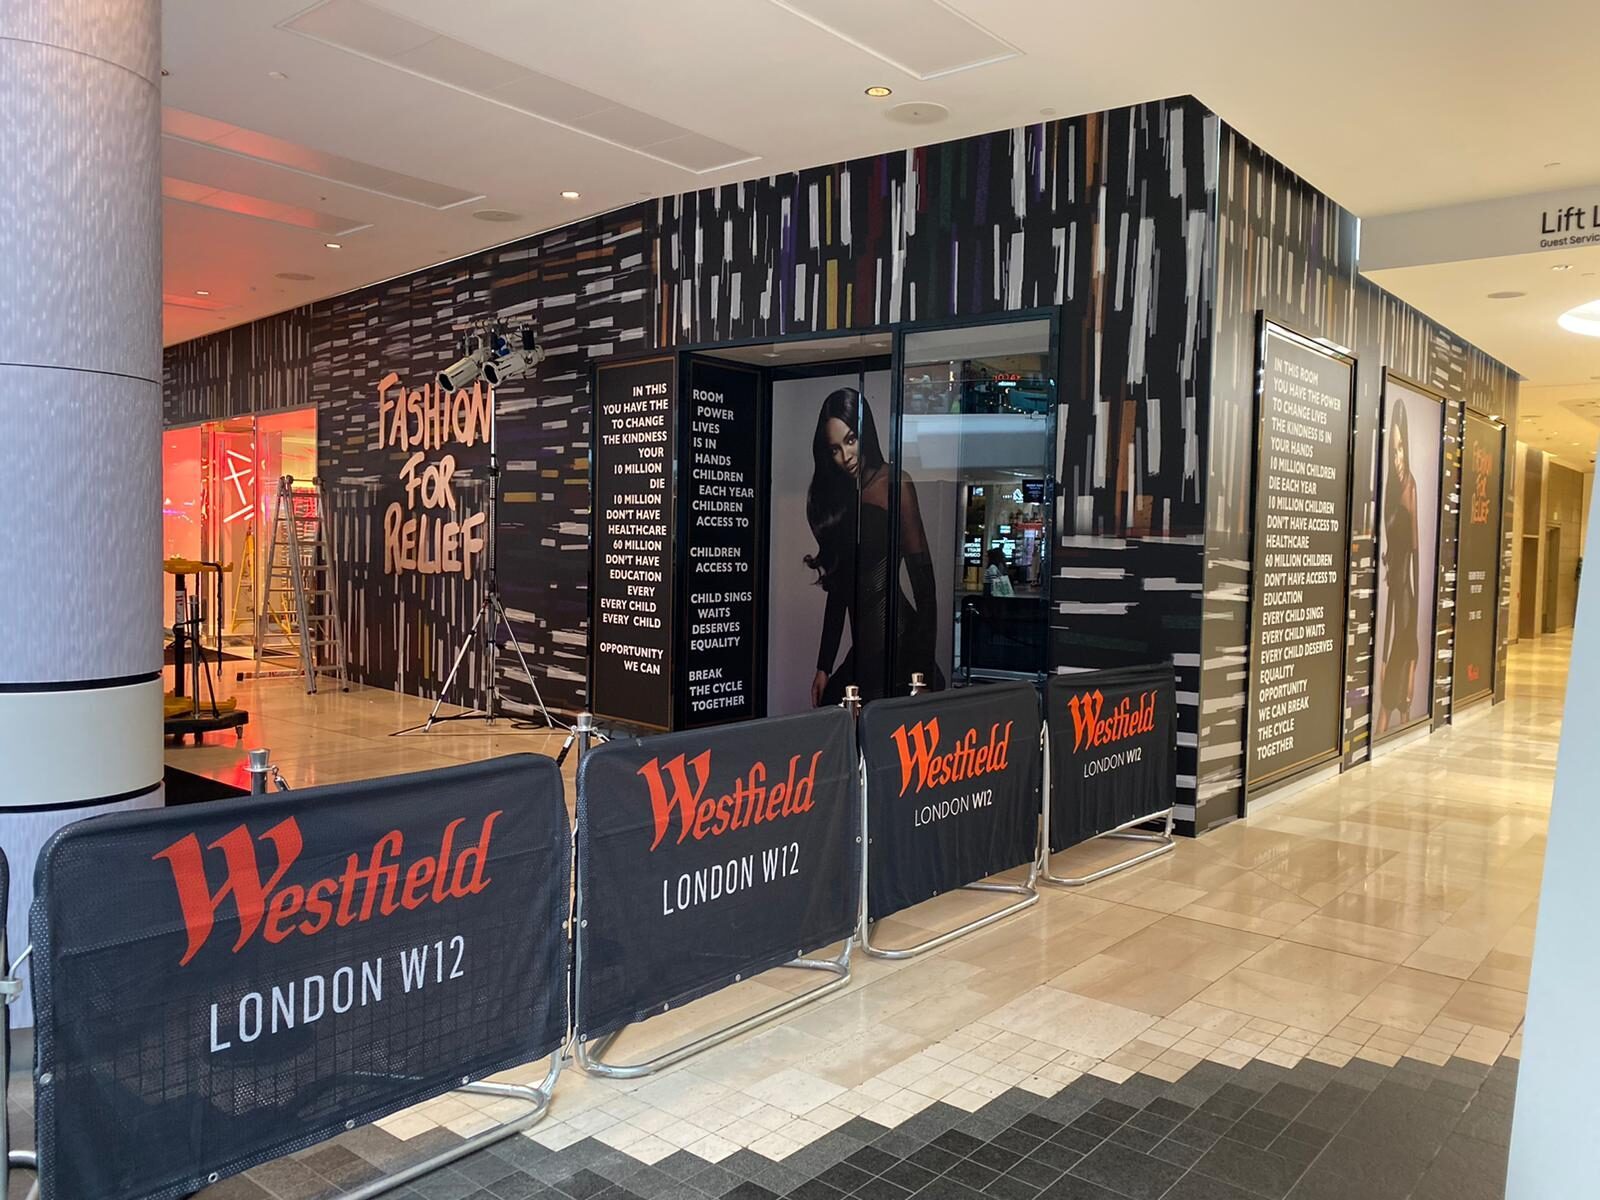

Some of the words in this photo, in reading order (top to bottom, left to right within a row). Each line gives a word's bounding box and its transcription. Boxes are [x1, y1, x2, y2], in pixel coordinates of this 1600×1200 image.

[1542, 207, 1586, 234] Lift
[1540, 237, 1568, 247] Guest
[1274, 357, 1282, 371] IN
[1284, 361, 1299, 378] THIS
[1301, 368, 1319, 385] ROOM
[633, 386, 643, 397] IN
[645, 383, 667, 395] THIS
[693, 389, 724, 403] ROOM
[1274, 377, 1289, 394] YOU
[1290, 384, 1306, 400] HAVE
[1308, 390, 1320, 405] THE
[1320, 395, 1341, 411] POWER
[377, 372, 492, 451] FASHION
[603, 404, 622, 415] YOU
[624, 402, 648, 413] HAVE
[649, 399, 668, 410] THE
[697, 406, 734, 420] POWER
[1272, 397, 1282, 412] TO
[1284, 402, 1310, 420] CHANGE
[1311, 410, 1327, 425] LIVES
[612, 419, 624, 429] TO
[625, 415, 664, 428] CHANGE
[692, 421, 720, 434] LIVES
[603, 435, 620, 444] THE
[622, 431, 667, 444] KINDNESS
[1272, 417, 1286, 433] THE
[1287, 421, 1318, 440] KINDNESS
[1318, 429, 1324, 442] IS
[1325, 431, 1332, 444] IN
[693, 437, 702, 448] IS
[705, 438, 716, 449] IN
[1271, 437, 1290, 453] YOUR
[1290, 443, 1314, 458] HANDS
[638, 447, 664, 458] YOUR
[695, 453, 731, 466] HANDS
[614, 464, 622, 474] 10
[625, 463, 662, 474] MILLION
[1270, 456, 1277, 470] 10
[1278, 458, 1305, 475] MILLION
[1306, 463, 1336, 479] CHILDREN
[400, 451, 456, 511] FOR
[650, 478, 665, 488] DIE
[693, 469, 743, 482] CHILDREN
[699, 485, 726, 496] EACH
[729, 487, 754, 498] YEAR
[1269, 476, 1280, 490] DIE
[1282, 479, 1299, 492] EACH
[1300, 482, 1317, 495] YEAR
[614, 495, 623, 504] 10
[624, 494, 661, 504] MILLION
[692, 500, 743, 512] CHILDREN
[1268, 496, 1276, 509] 10
[1277, 497, 1304, 512] MILLION
[1305, 500, 1335, 514] CHILDREN
[606, 510, 634, 520] DON'T
[636, 510, 660, 520] HAVE
[696, 516, 733, 526] ACCESS
[736, 517, 749, 527] TO
[608, 525, 666, 535] HEALTHCARE
[1267, 515, 1289, 529] DON'T
[1290, 517, 1307, 530] HAVE
[1308, 518, 1330, 532] ACCESS
[1330, 520, 1338, 532] TO
[384, 502, 485, 580] RELIEF
[613, 539, 623, 550] 60
[624, 540, 662, 550] MILLION
[1266, 535, 1309, 549] HEALTHCARE
[690, 547, 741, 557] CHILDREN
[606, 554, 633, 565] DON'T
[635, 556, 660, 566] HAVE
[696, 562, 732, 572] ACCESS
[735, 562, 748, 572] TO
[1265, 554, 1273, 568] 60
[1274, 554, 1301, 567] MILLION
[1302, 554, 1332, 566] CHILDREN
[610, 569, 662, 582] EDUCATION
[1264, 573, 1286, 587] DON'T
[1287, 572, 1304, 585] HAVE
[1306, 571, 1328, 584] ACCESS
[1329, 571, 1337, 583] TO
[628, 585, 655, 596] EVERY
[691, 593, 722, 603] CHILD
[724, 592, 752, 602] SINGS
[601, 598, 627, 610] EVERY
[629, 602, 656, 612] CHILD
[1264, 591, 1303, 606] EDUCATION
[603, 613, 629, 625] EVERY
[633, 616, 661, 628] CHILD
[698, 608, 731, 619] WAITS
[1263, 610, 1284, 625] EVERY
[1285, 608, 1305, 622] CHILD
[1306, 606, 1324, 620] SINGS
[692, 622, 740, 634] DESERVES
[1262, 629, 1284, 645] EVERY
[1285, 626, 1304, 642] CHILD
[1305, 624, 1325, 638] WAITS
[600, 642, 664, 660] OPPORTUNITY
[691, 637, 740, 651] EQUALITY
[1261, 648, 1283, 664] EVERY
[1284, 644, 1304, 661] CHILD
[1304, 640, 1333, 656] DESERVES
[624, 660, 638, 672] WE
[640, 663, 660, 675] CAN
[689, 668, 723, 681] BREAK
[1260, 664, 1294, 685] EQUALITY
[690, 685, 710, 696] THE
[713, 681, 743, 694] CYCLE
[1259, 679, 1308, 703] OPPORTUNITY
[692, 695, 744, 712] TOGETHER
[1259, 705, 1271, 722] WE
[1272, 701, 1287, 719] CAN
[1287, 696, 1309, 715] BREAK
[1067, 688, 1158, 755] Westfield
[1258, 725, 1273, 741] THE
[1274, 718, 1294, 737] CYCLE
[1257, 736, 1294, 760] TOGETHER
[890, 716, 1014, 798] Westfield
[1083, 752, 1124, 778] LONDON
[1126, 746, 1142, 764] W12
[636, 748, 823, 852] Westfield
[914, 797, 968, 828] LONDON
[971, 788, 993, 814] W12
[662, 853, 754, 916] LONDON
[761, 842, 800, 884] W12
[151, 809, 503, 967] Westfield
[209, 957, 384, 1053] LONDON
[400, 935, 465, 993] W12
